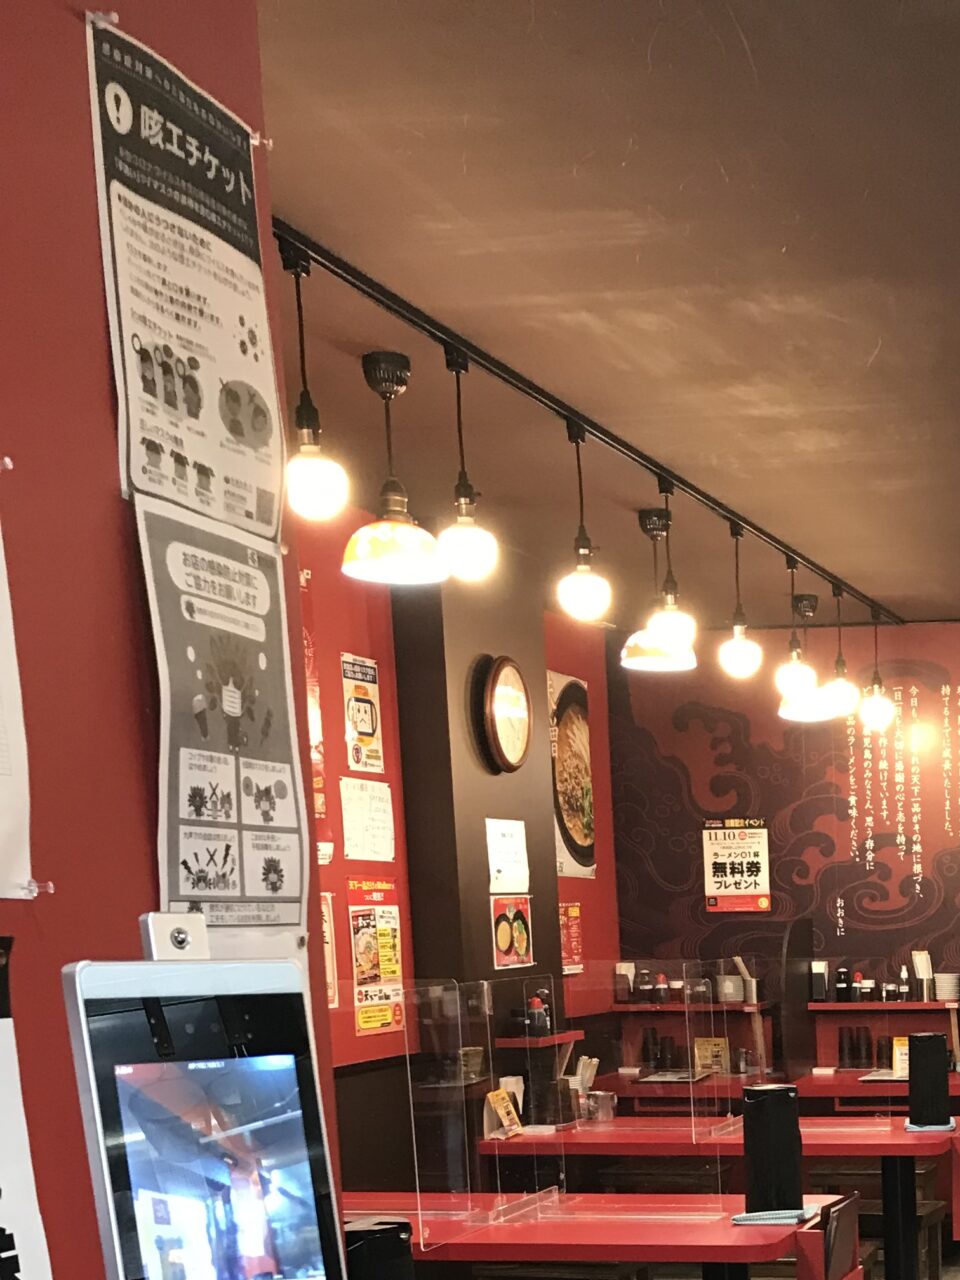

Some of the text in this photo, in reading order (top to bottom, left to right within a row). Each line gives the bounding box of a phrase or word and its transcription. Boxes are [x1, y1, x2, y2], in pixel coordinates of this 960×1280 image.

[140, 104, 252, 205] 咳エチケット
[184, 571, 258, 611] ご協力をお願いします
[712, 861, 761, 878] 無料券
[714, 880, 760, 890] プレゼント
[836, 897, 845, 937] おおきに
